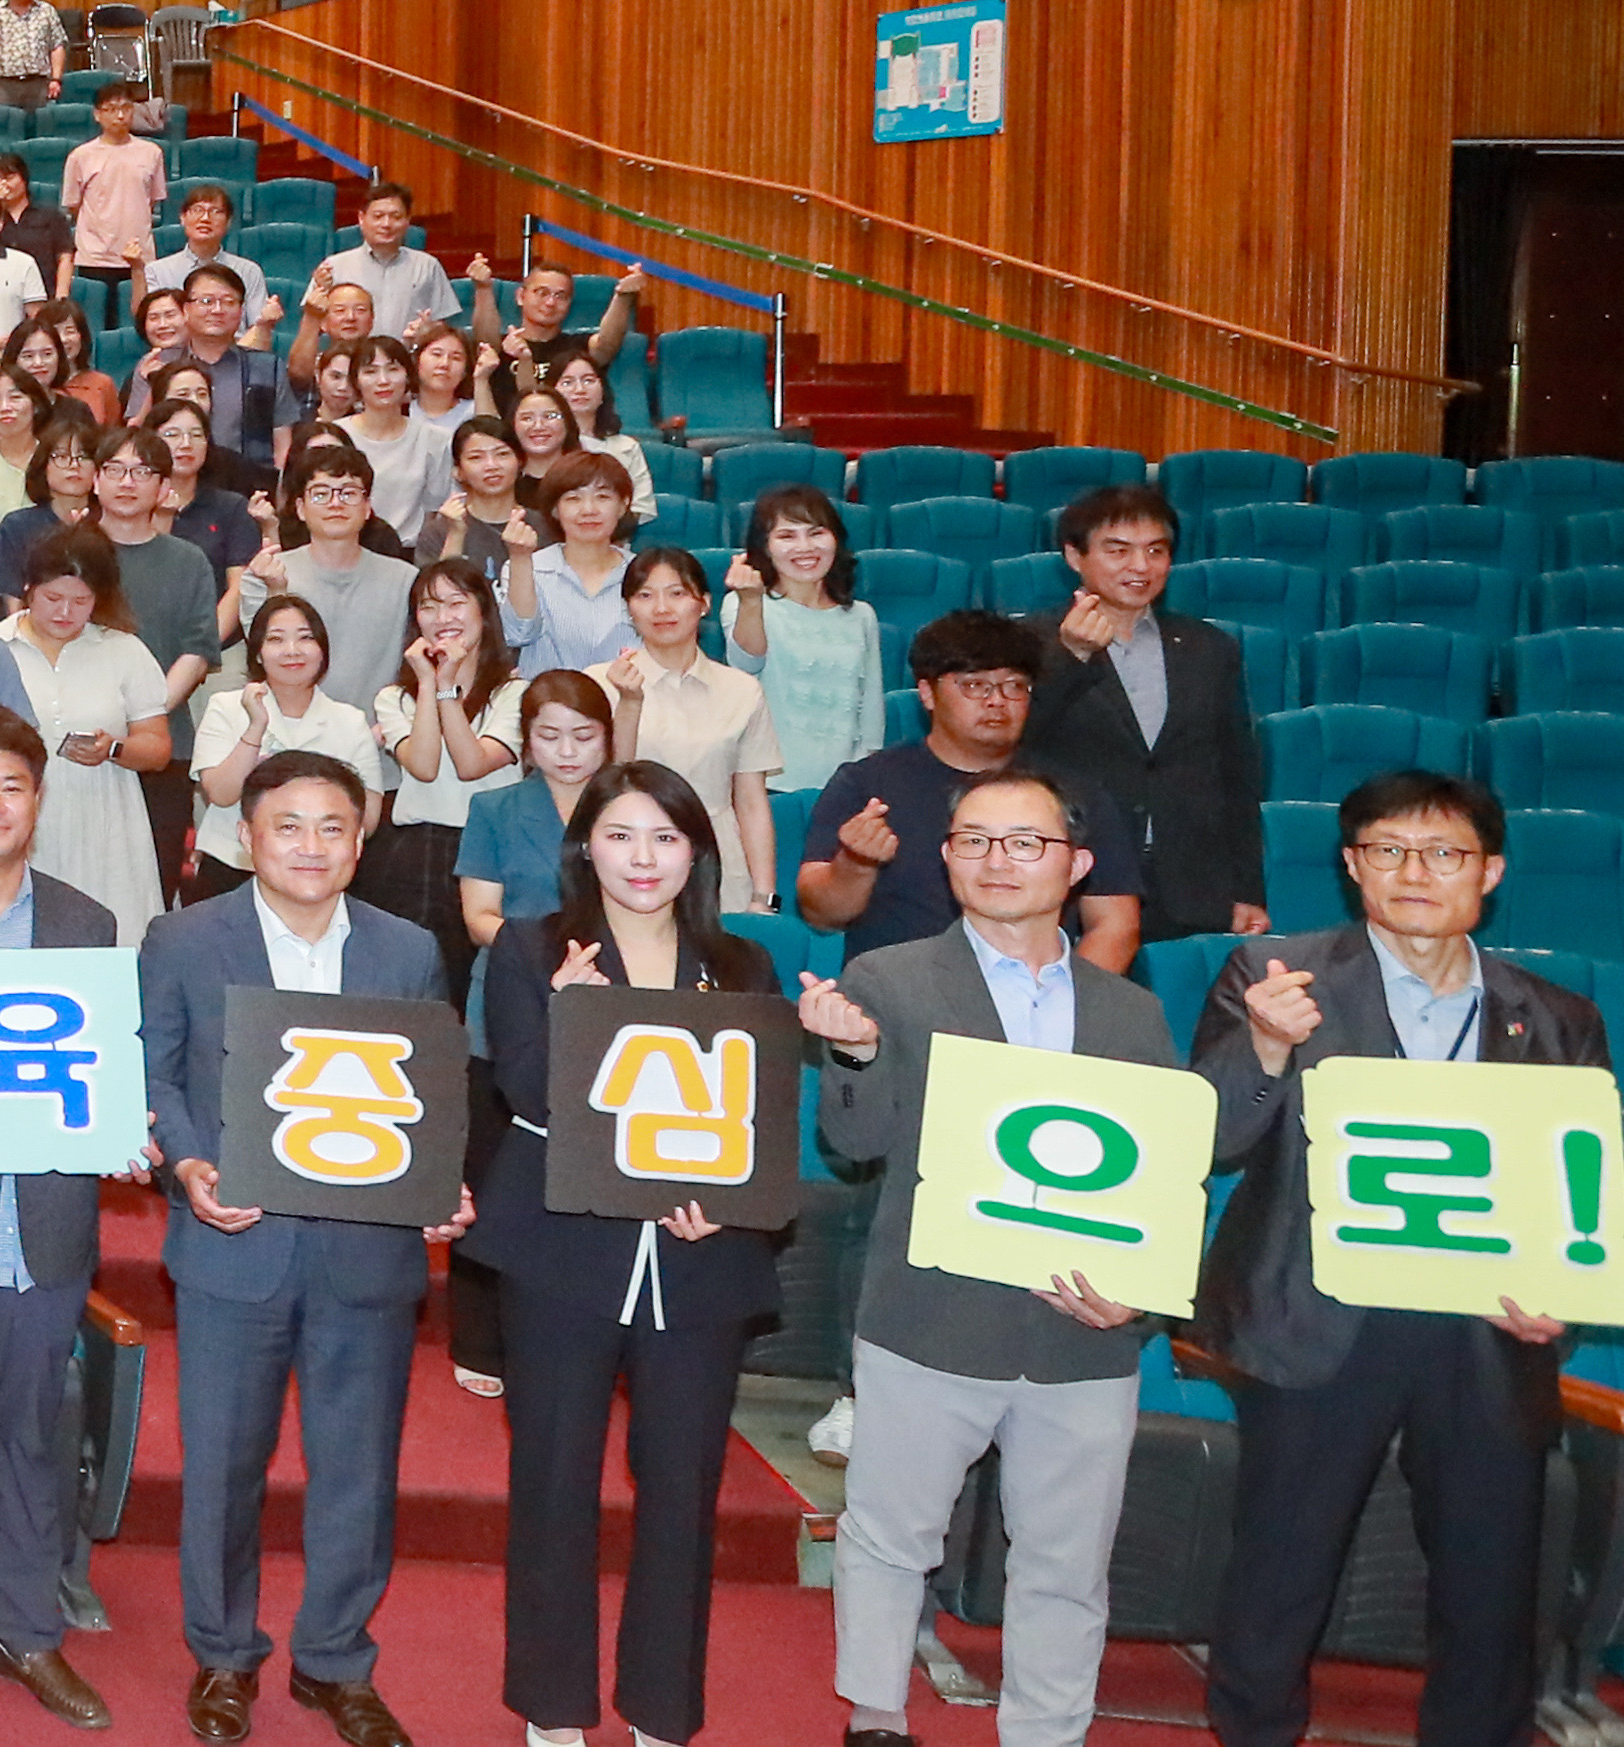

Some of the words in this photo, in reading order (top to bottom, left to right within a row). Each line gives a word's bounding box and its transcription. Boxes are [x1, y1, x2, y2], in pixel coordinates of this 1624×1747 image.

[273, 1035, 417, 1178] 중
[601, 1034, 750, 1177] 심
[976, 1104, 1144, 1243] 으
[1337, 1121, 1606, 1266] 로!
